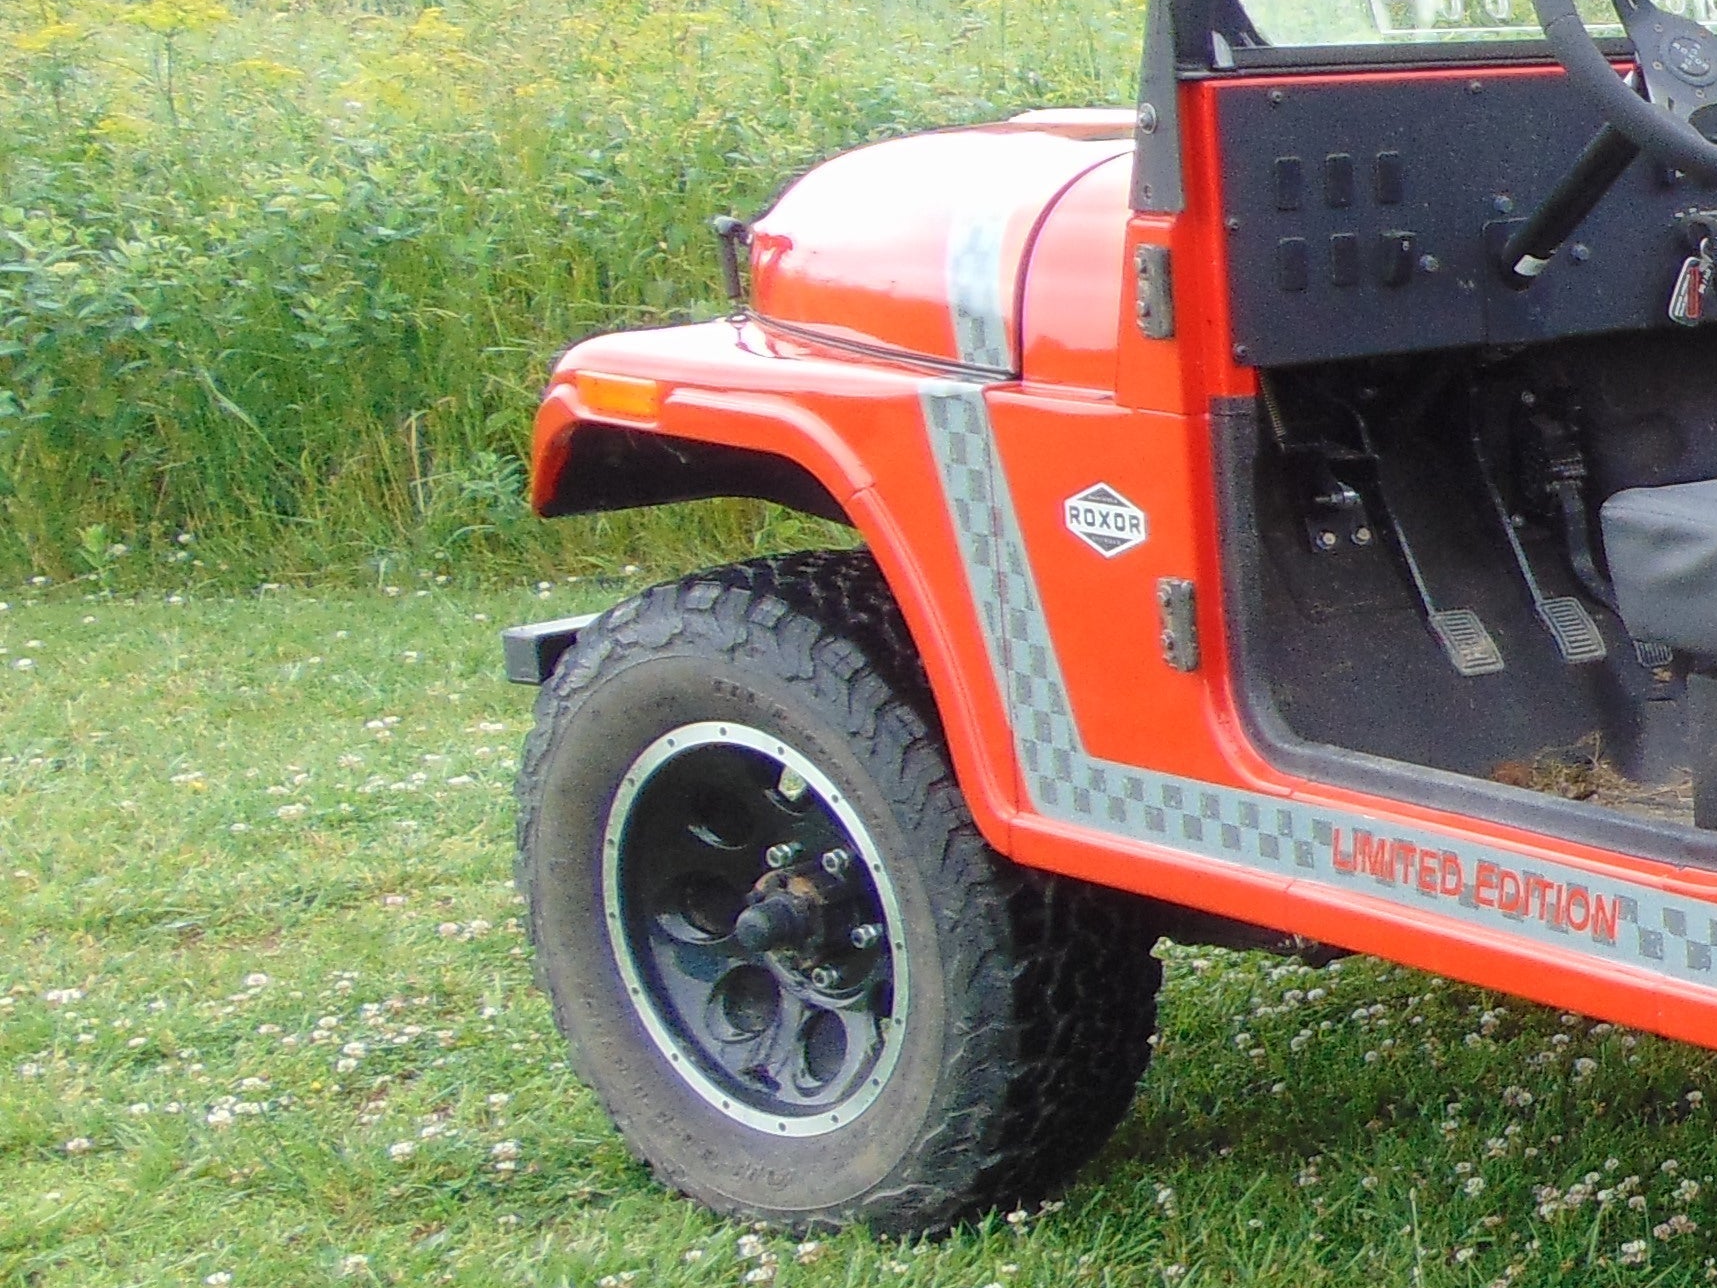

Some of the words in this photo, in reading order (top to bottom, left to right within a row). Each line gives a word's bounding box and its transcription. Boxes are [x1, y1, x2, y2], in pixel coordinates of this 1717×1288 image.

[1068, 505, 1142, 535] ROXOR
[1331, 827, 1465, 898] LIMITED
[1473, 860, 1620, 941] EDITION
